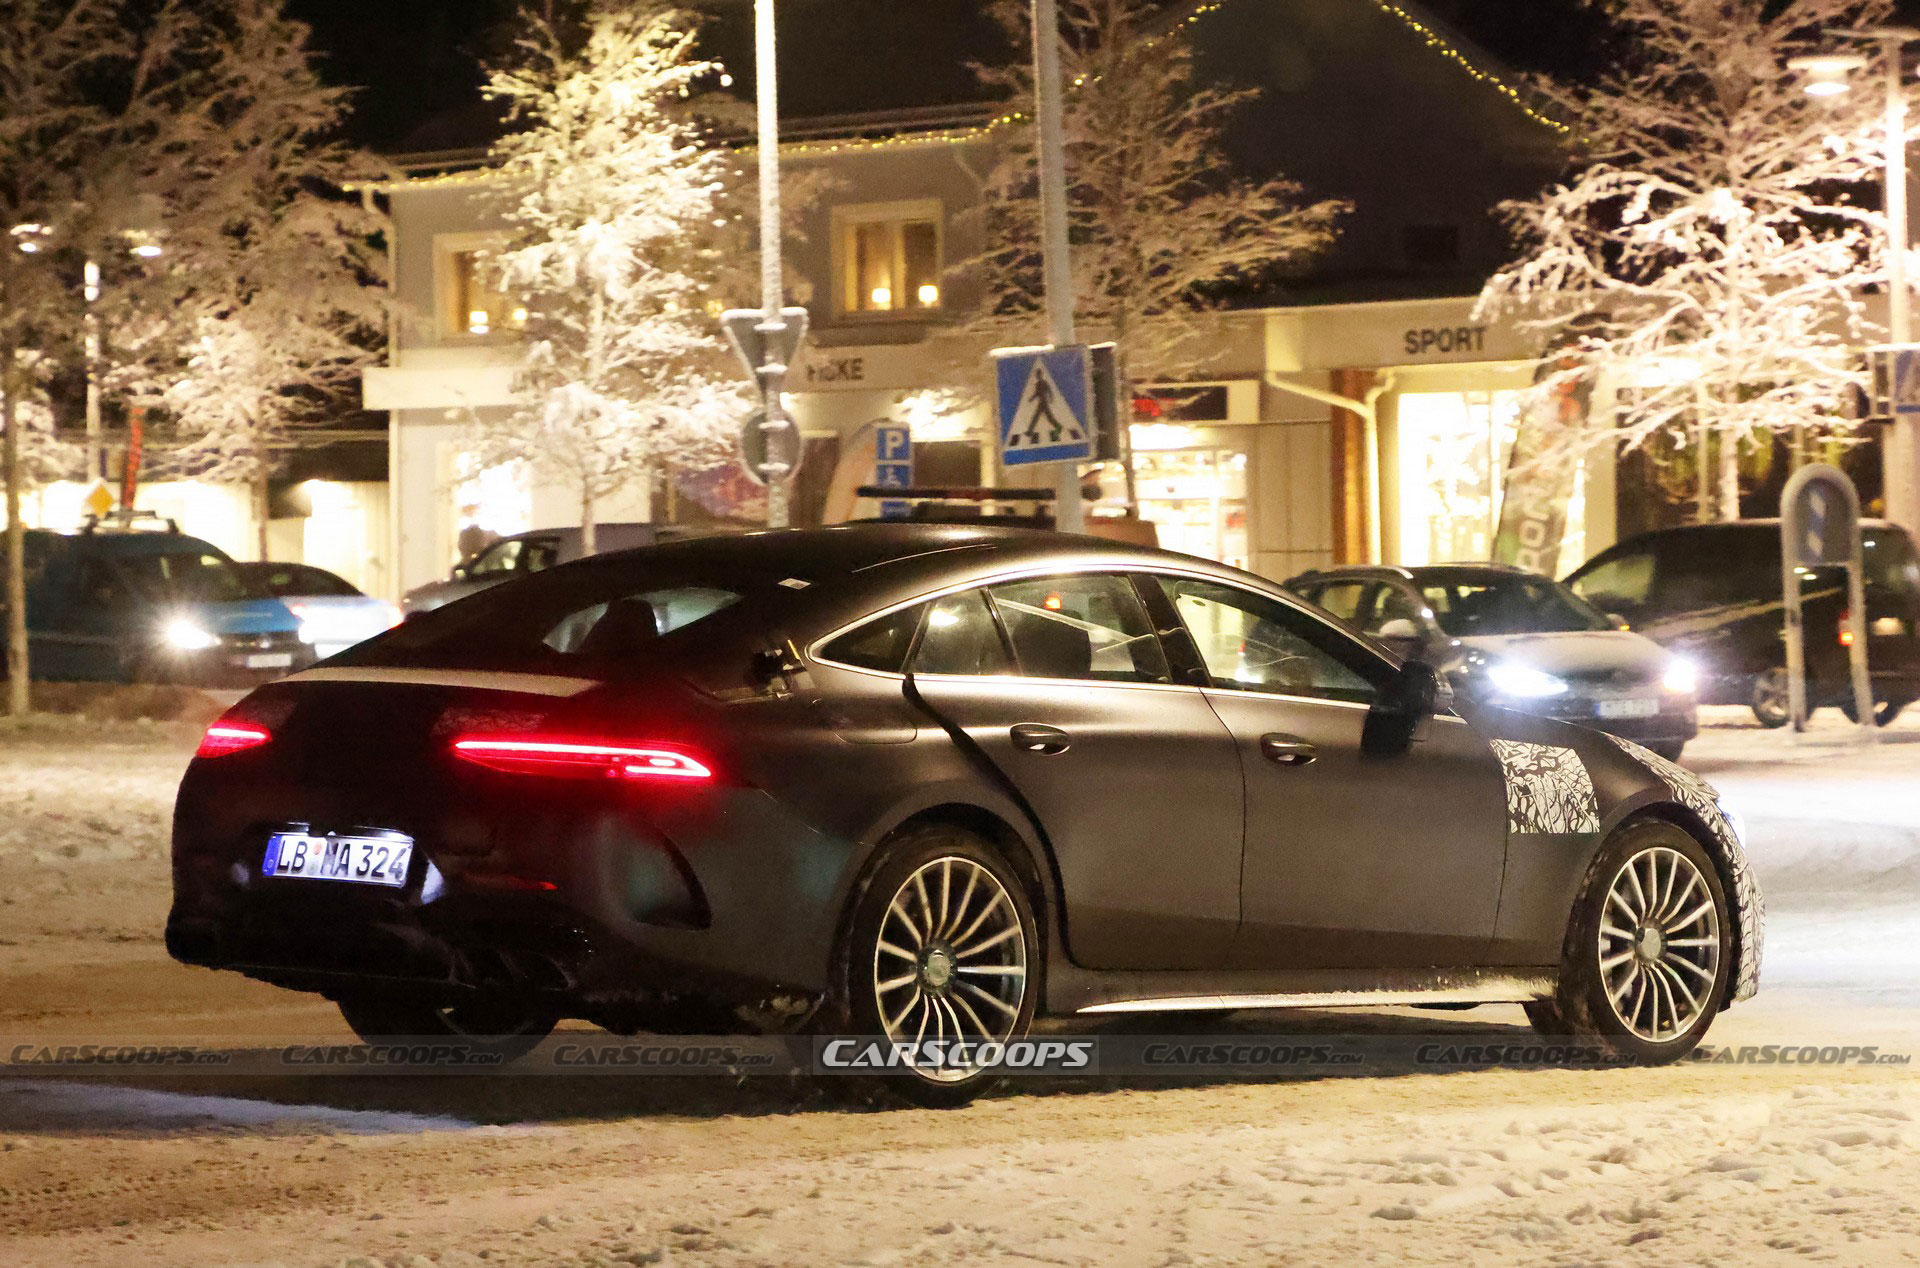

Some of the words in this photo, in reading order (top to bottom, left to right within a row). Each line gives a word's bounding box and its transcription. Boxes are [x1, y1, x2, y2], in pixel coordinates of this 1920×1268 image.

[1405, 326, 1486, 354] SPORT
[886, 431, 904, 458] P
[276, 839, 309, 874] LB
[356, 844, 408, 881] 324
